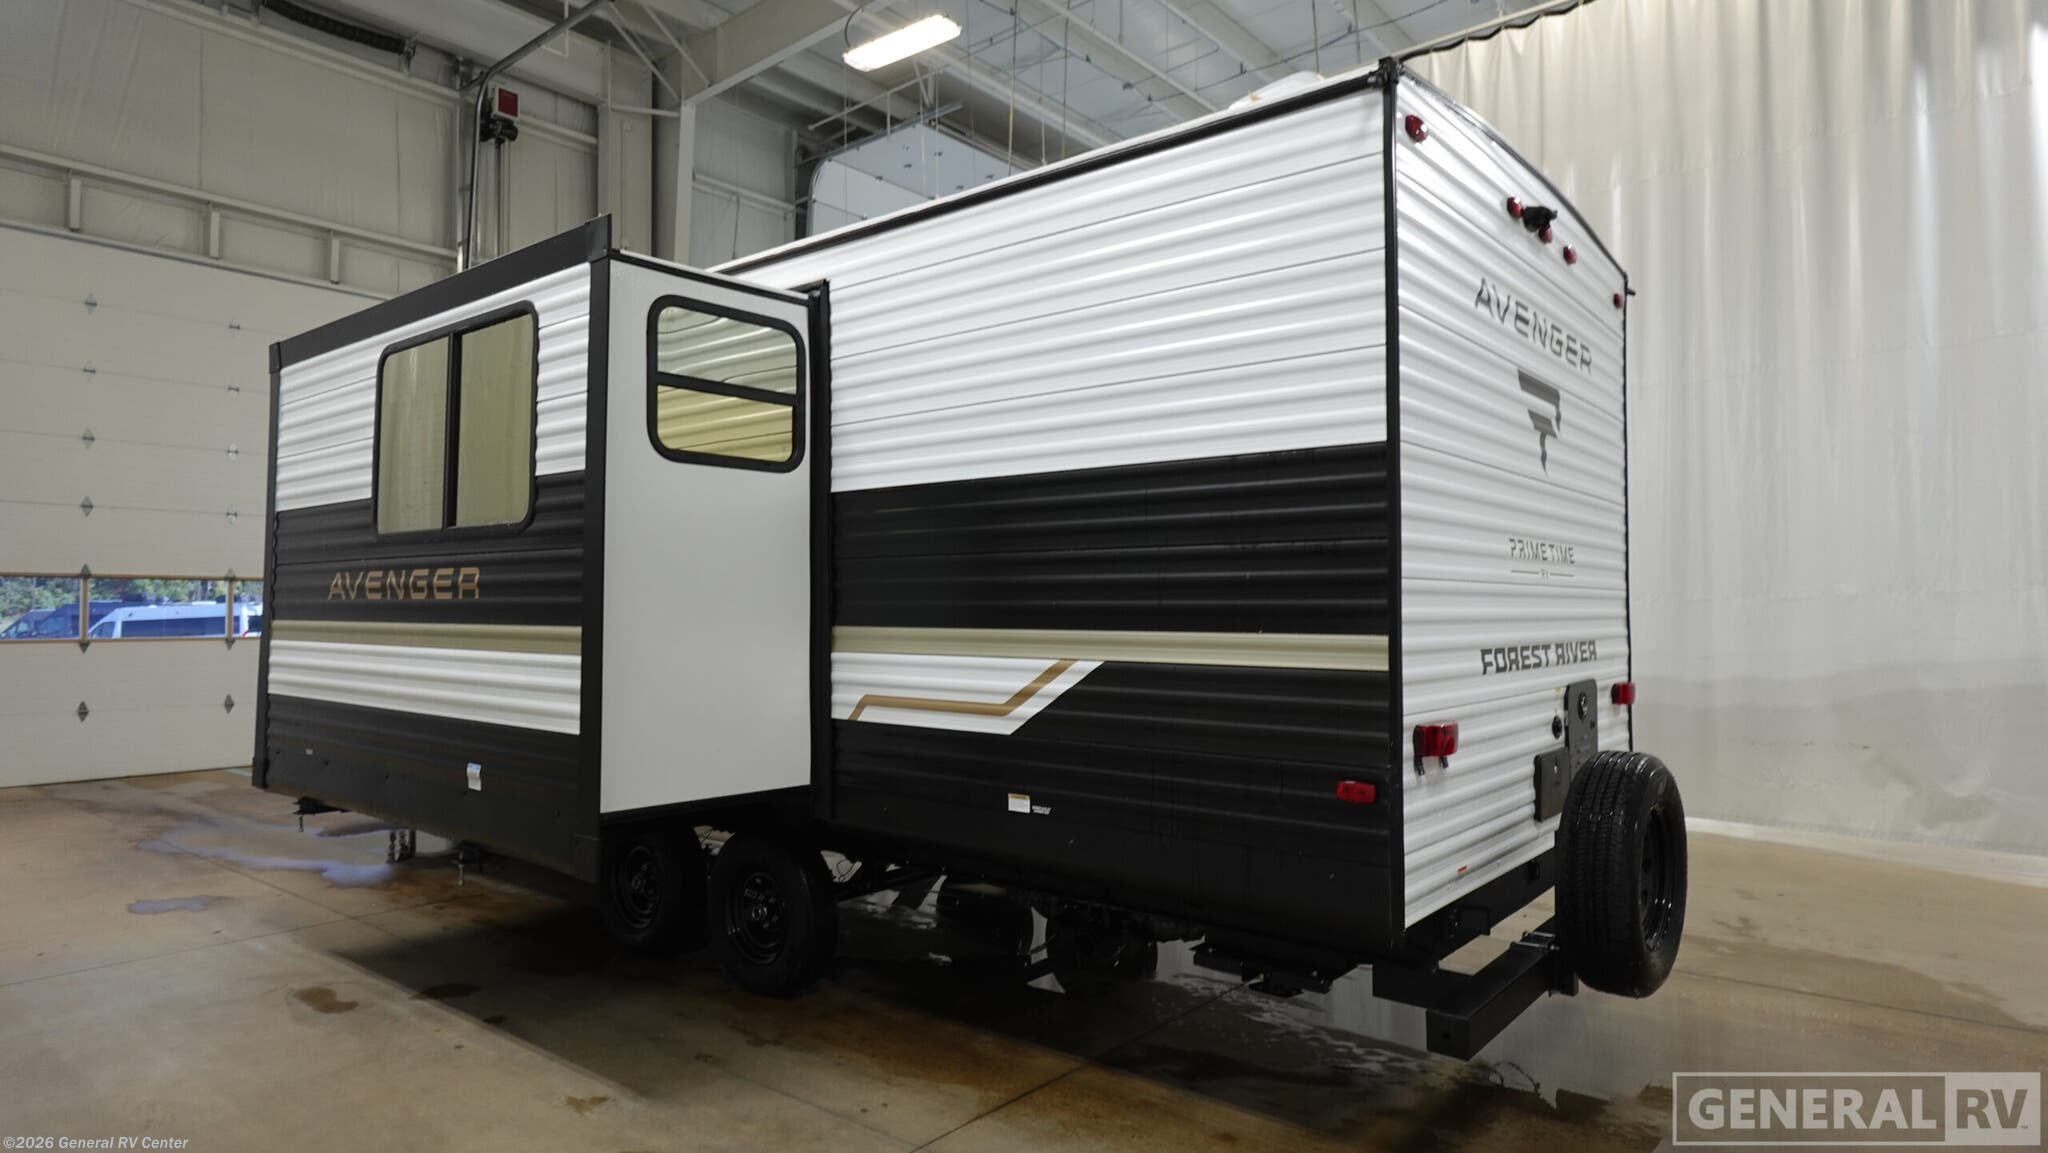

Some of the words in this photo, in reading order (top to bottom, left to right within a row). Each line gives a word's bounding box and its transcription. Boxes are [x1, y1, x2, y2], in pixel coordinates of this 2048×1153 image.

[1475, 277, 1592, 376] AVENGER
[328, 567, 480, 600] AVENGER
[1480, 644, 1551, 675] FOREST
[1554, 640, 1597, 666] RIVER
